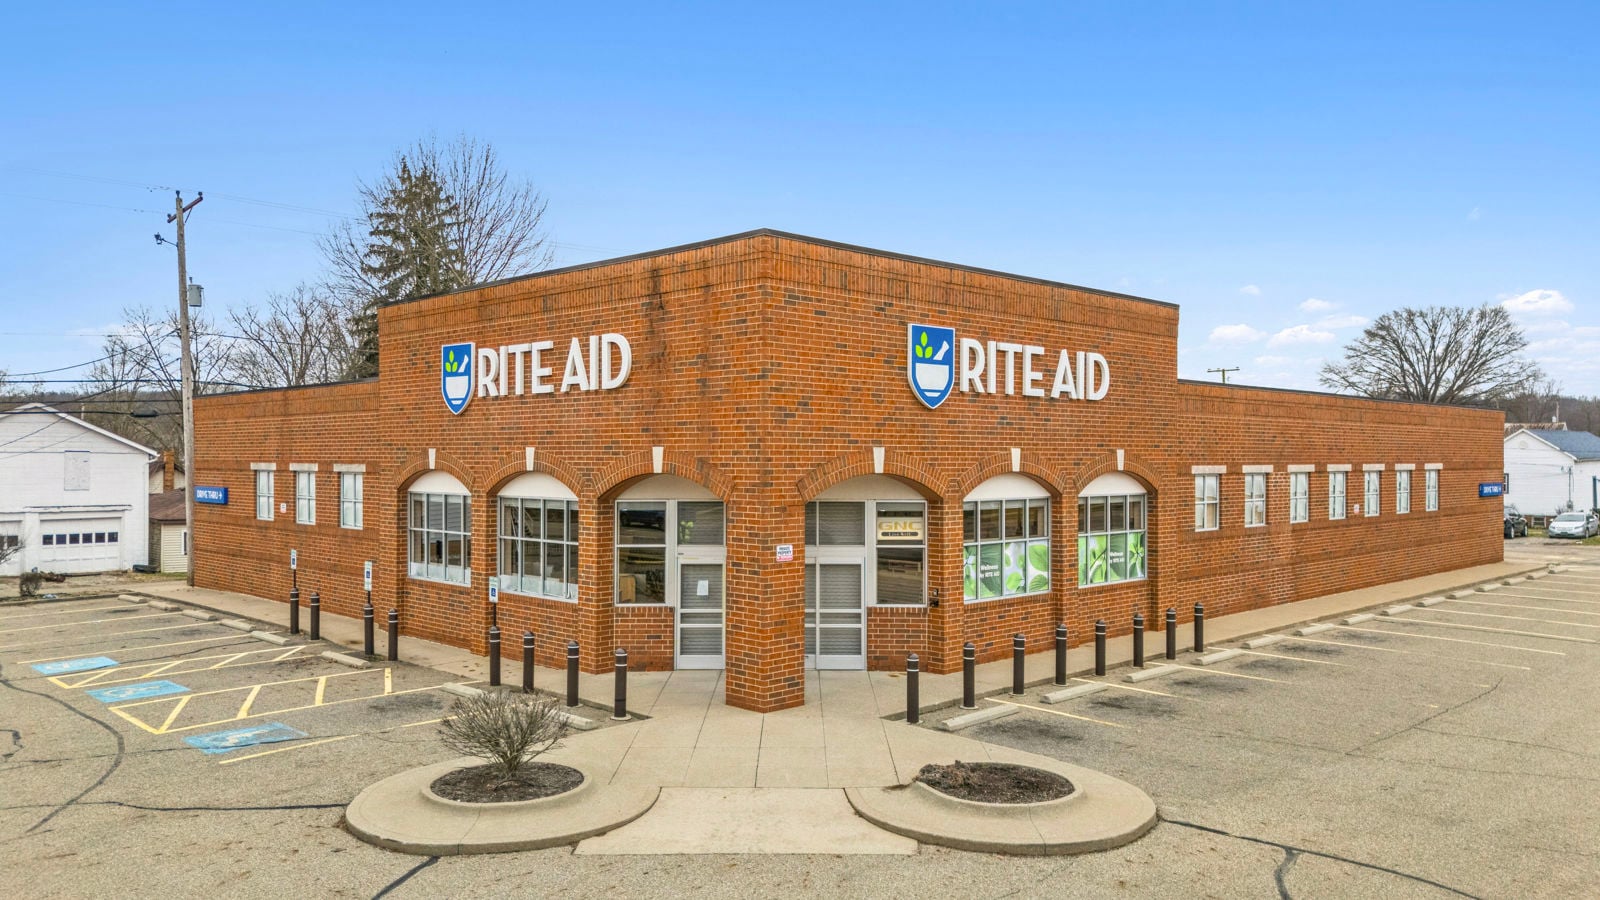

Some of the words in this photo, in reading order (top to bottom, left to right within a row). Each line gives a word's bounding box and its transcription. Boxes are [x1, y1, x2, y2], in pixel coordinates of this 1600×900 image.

[478, 341, 555, 398] RITE
[560, 332, 632, 393] AID
[959, 338, 1045, 397] RITE
[1050, 348, 1110, 401] AID
[878, 520, 923, 531] GNC
